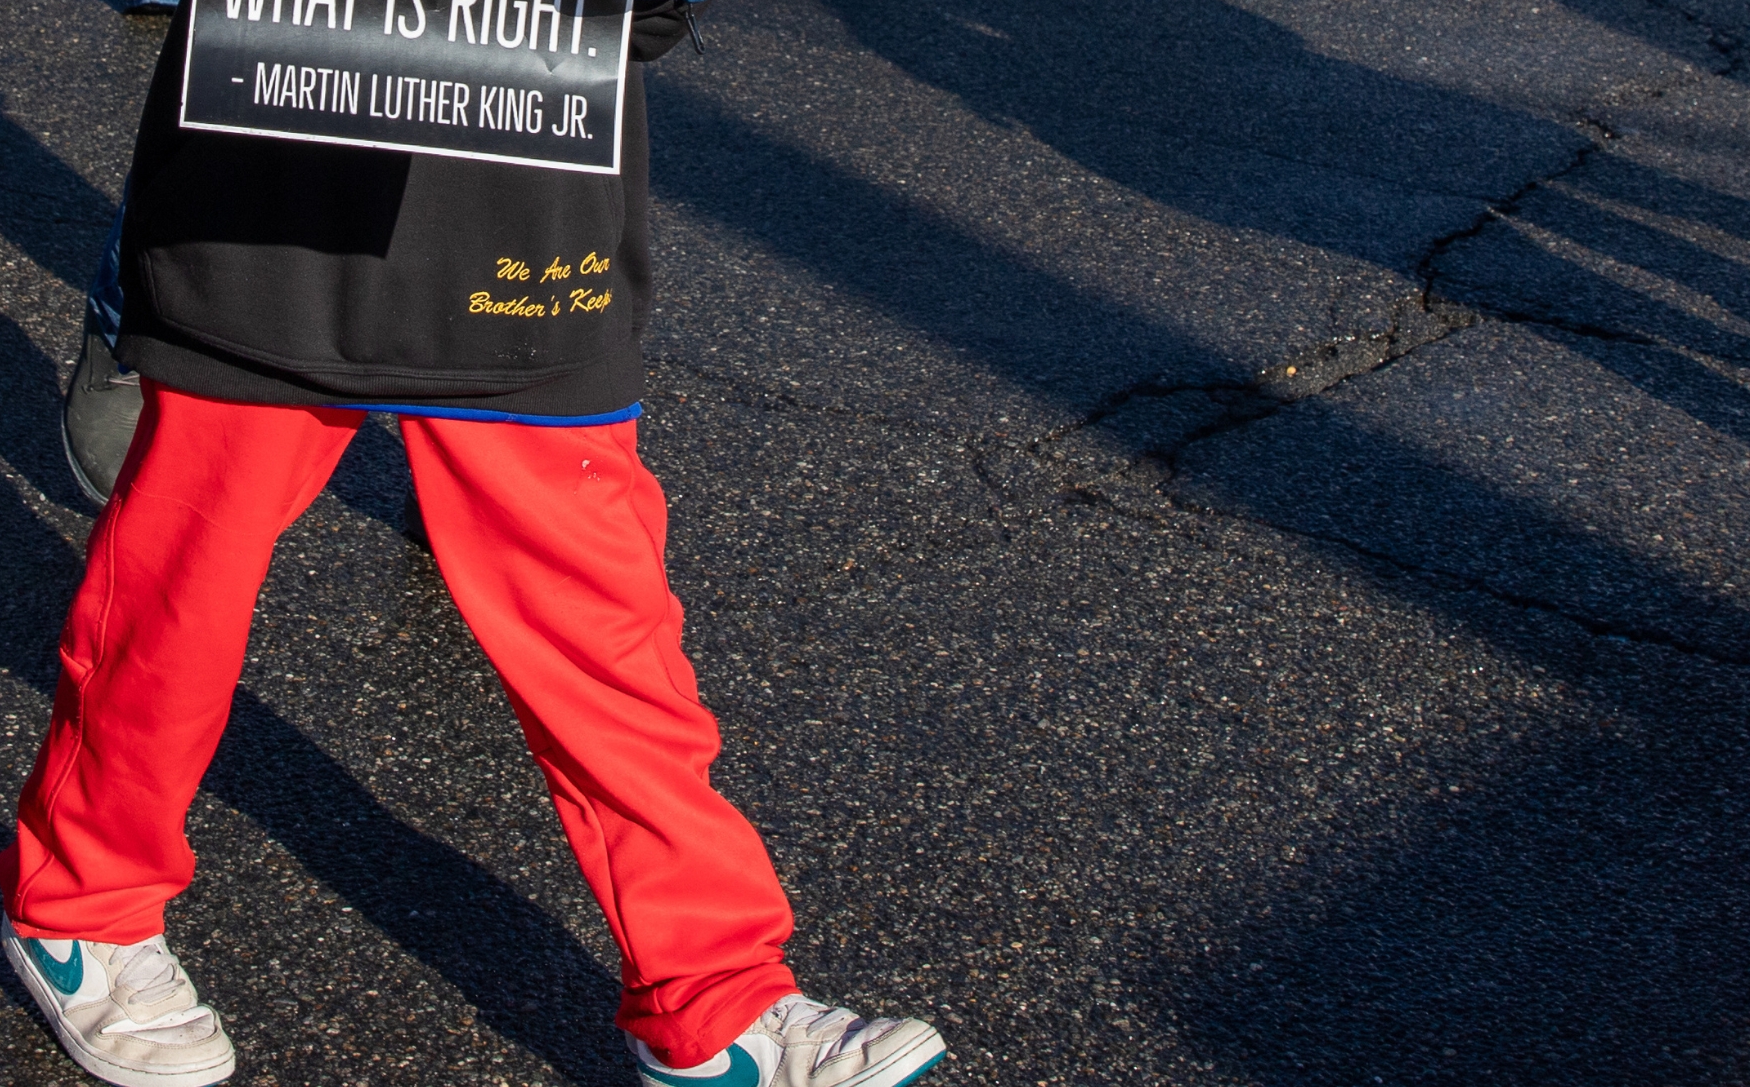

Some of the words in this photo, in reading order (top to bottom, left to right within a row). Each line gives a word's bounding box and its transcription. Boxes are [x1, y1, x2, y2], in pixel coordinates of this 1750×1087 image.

[252, 61, 361, 116] MARTIN
[368, 72, 470, 127] LUTHER
[477, 84, 544, 135] KING
[550, 93, 594, 141] JR.
[496, 255, 531, 282] We
[538, 255, 572, 284] Are
